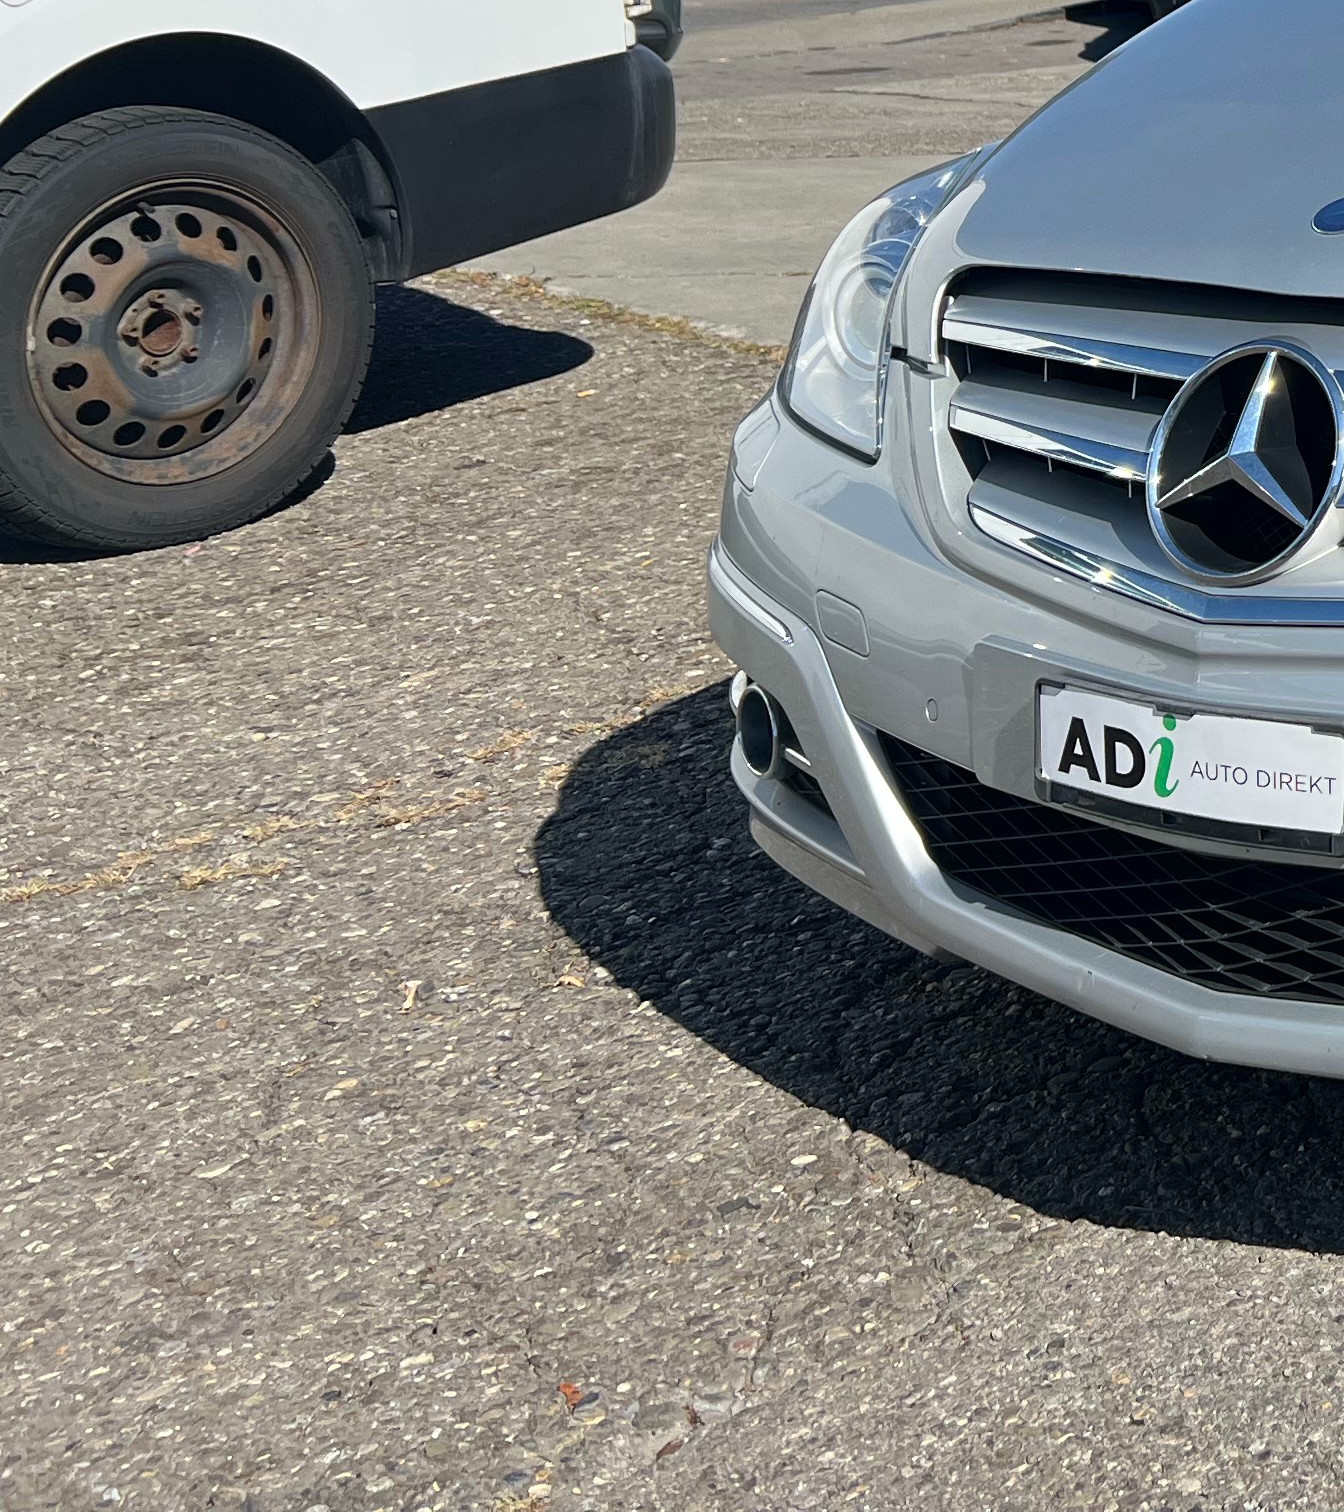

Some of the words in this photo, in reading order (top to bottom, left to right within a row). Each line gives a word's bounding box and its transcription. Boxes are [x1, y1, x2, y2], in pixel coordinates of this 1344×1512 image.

[1058, 713, 1180, 798] ADi
[1190, 760, 1248, 786] AUTO
[1256, 769, 1337, 795] DIREKT
